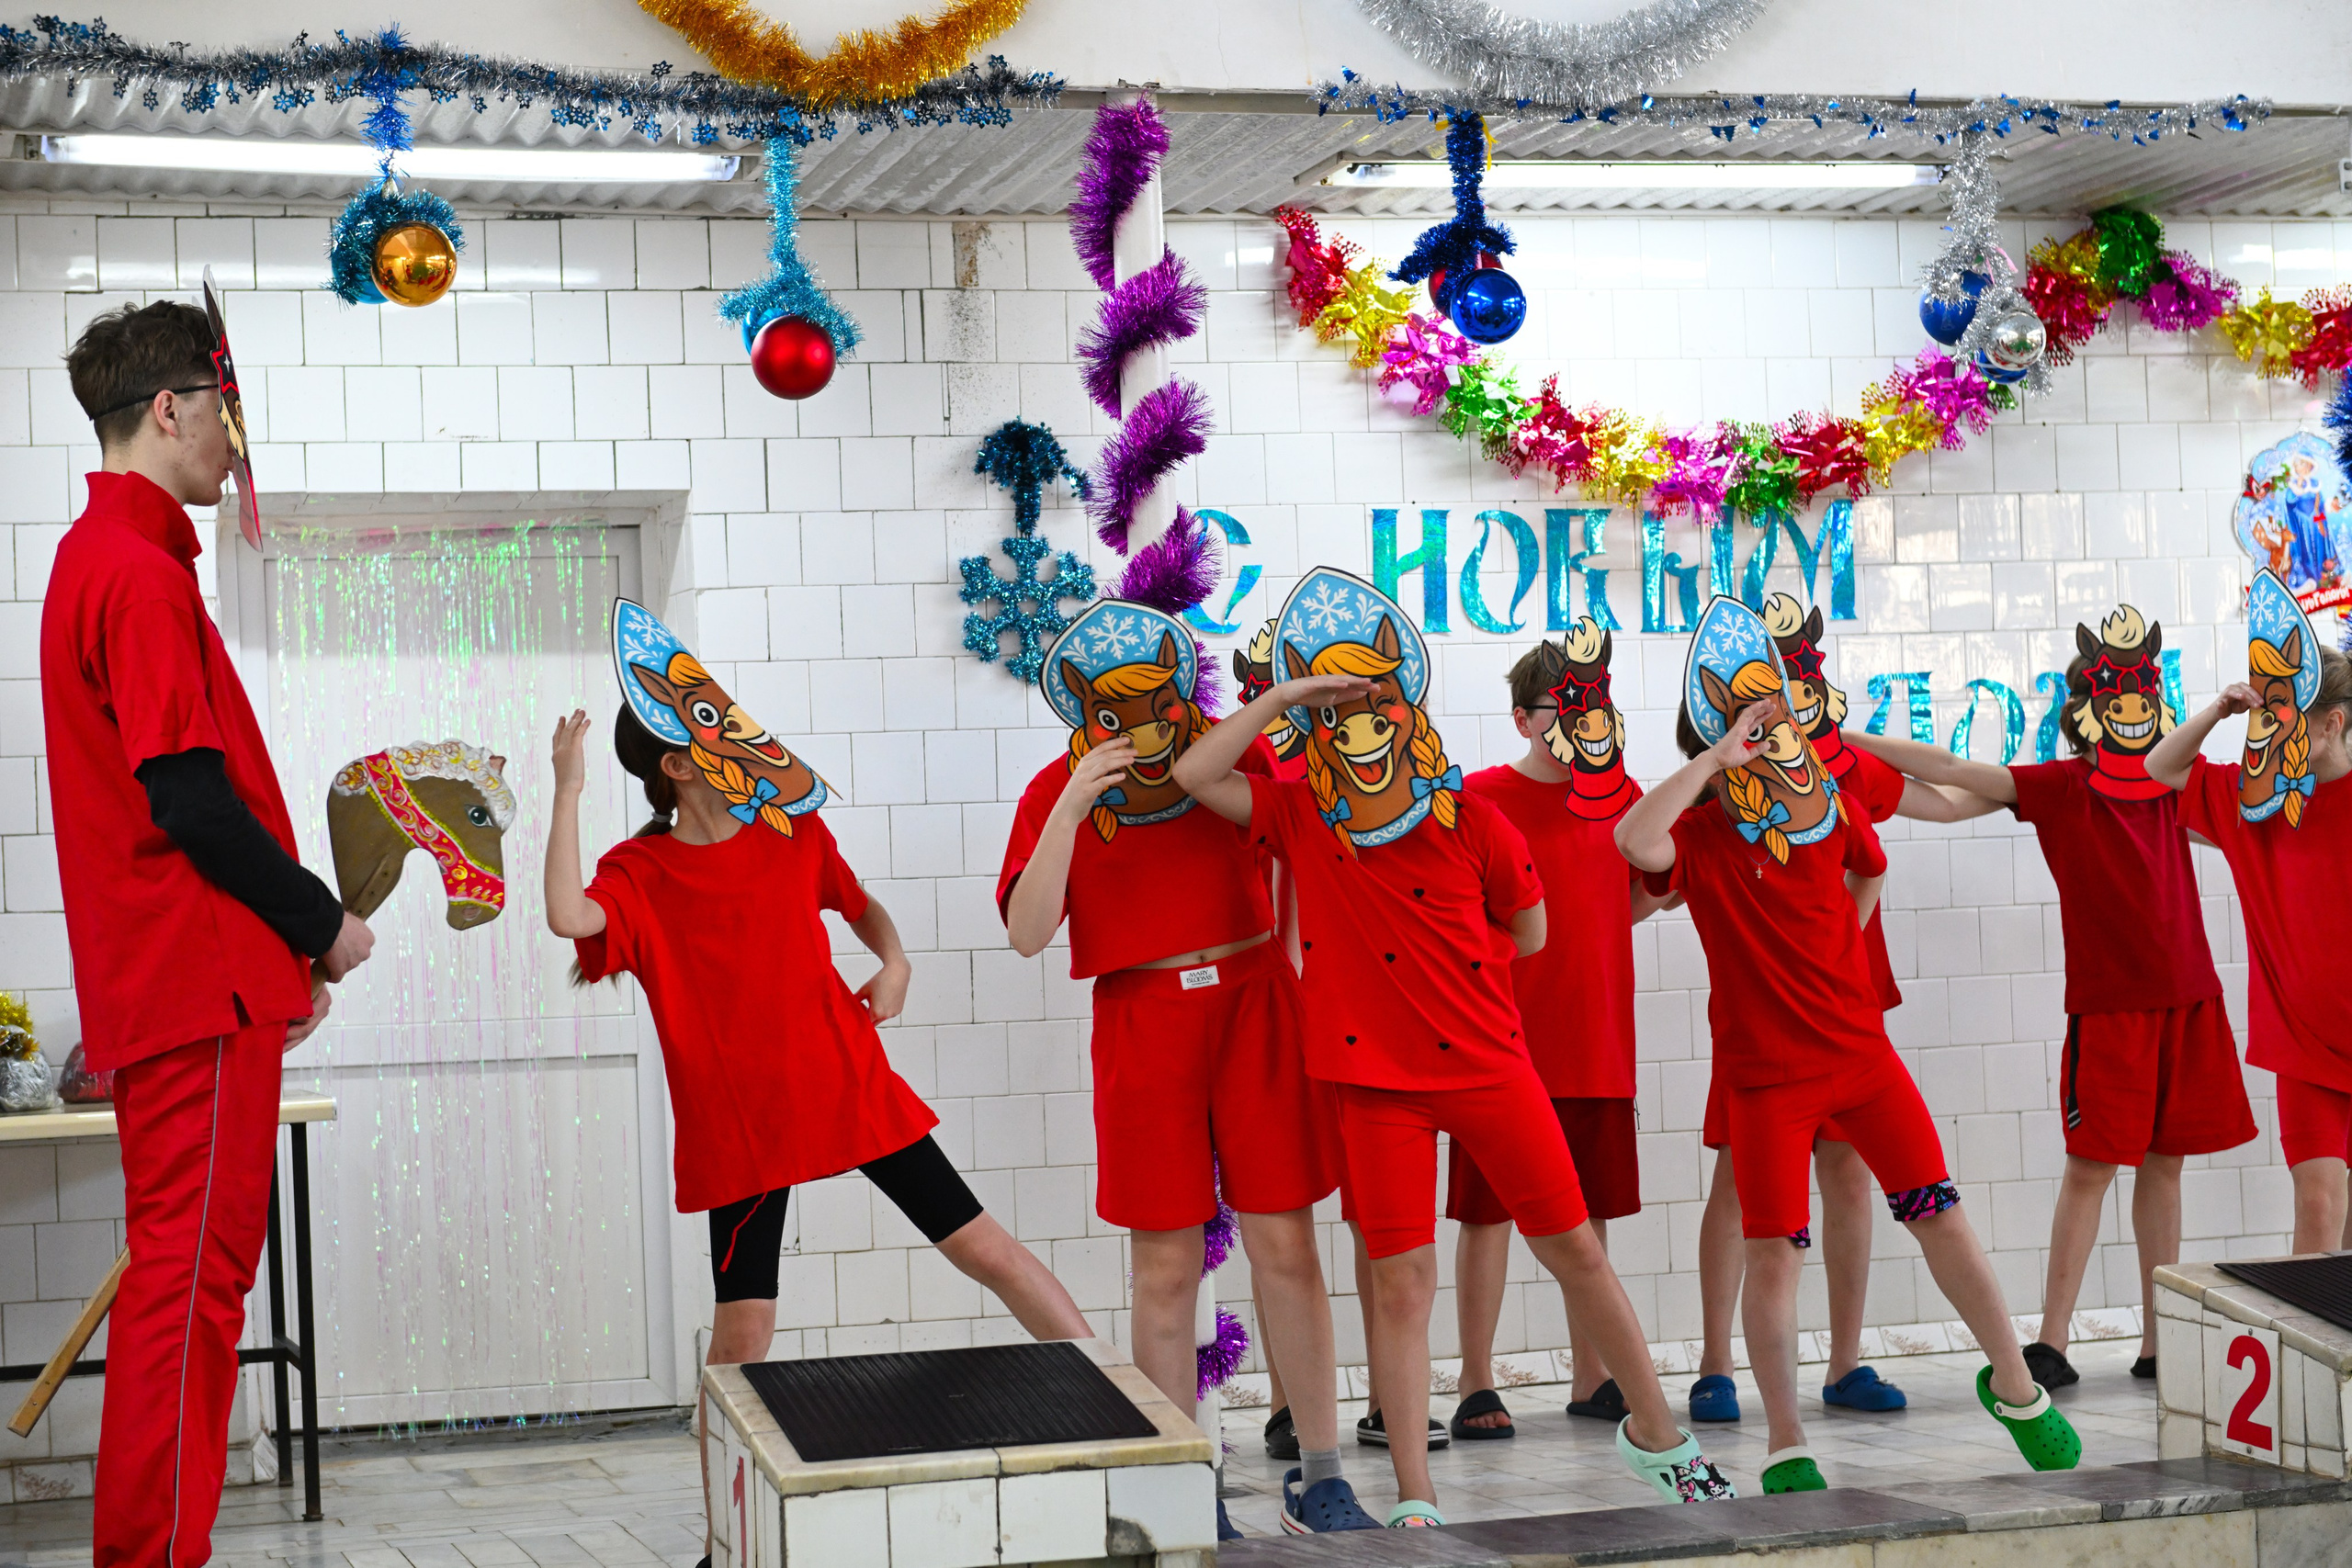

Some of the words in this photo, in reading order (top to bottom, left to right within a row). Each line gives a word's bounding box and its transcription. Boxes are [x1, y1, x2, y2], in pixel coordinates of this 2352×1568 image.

[1186, 974, 1214, 984] BLOOMS
[1189, 969, 1209, 977] MARY
[2226, 1335, 2273, 1452] 2
[732, 1455, 748, 1568] 1
